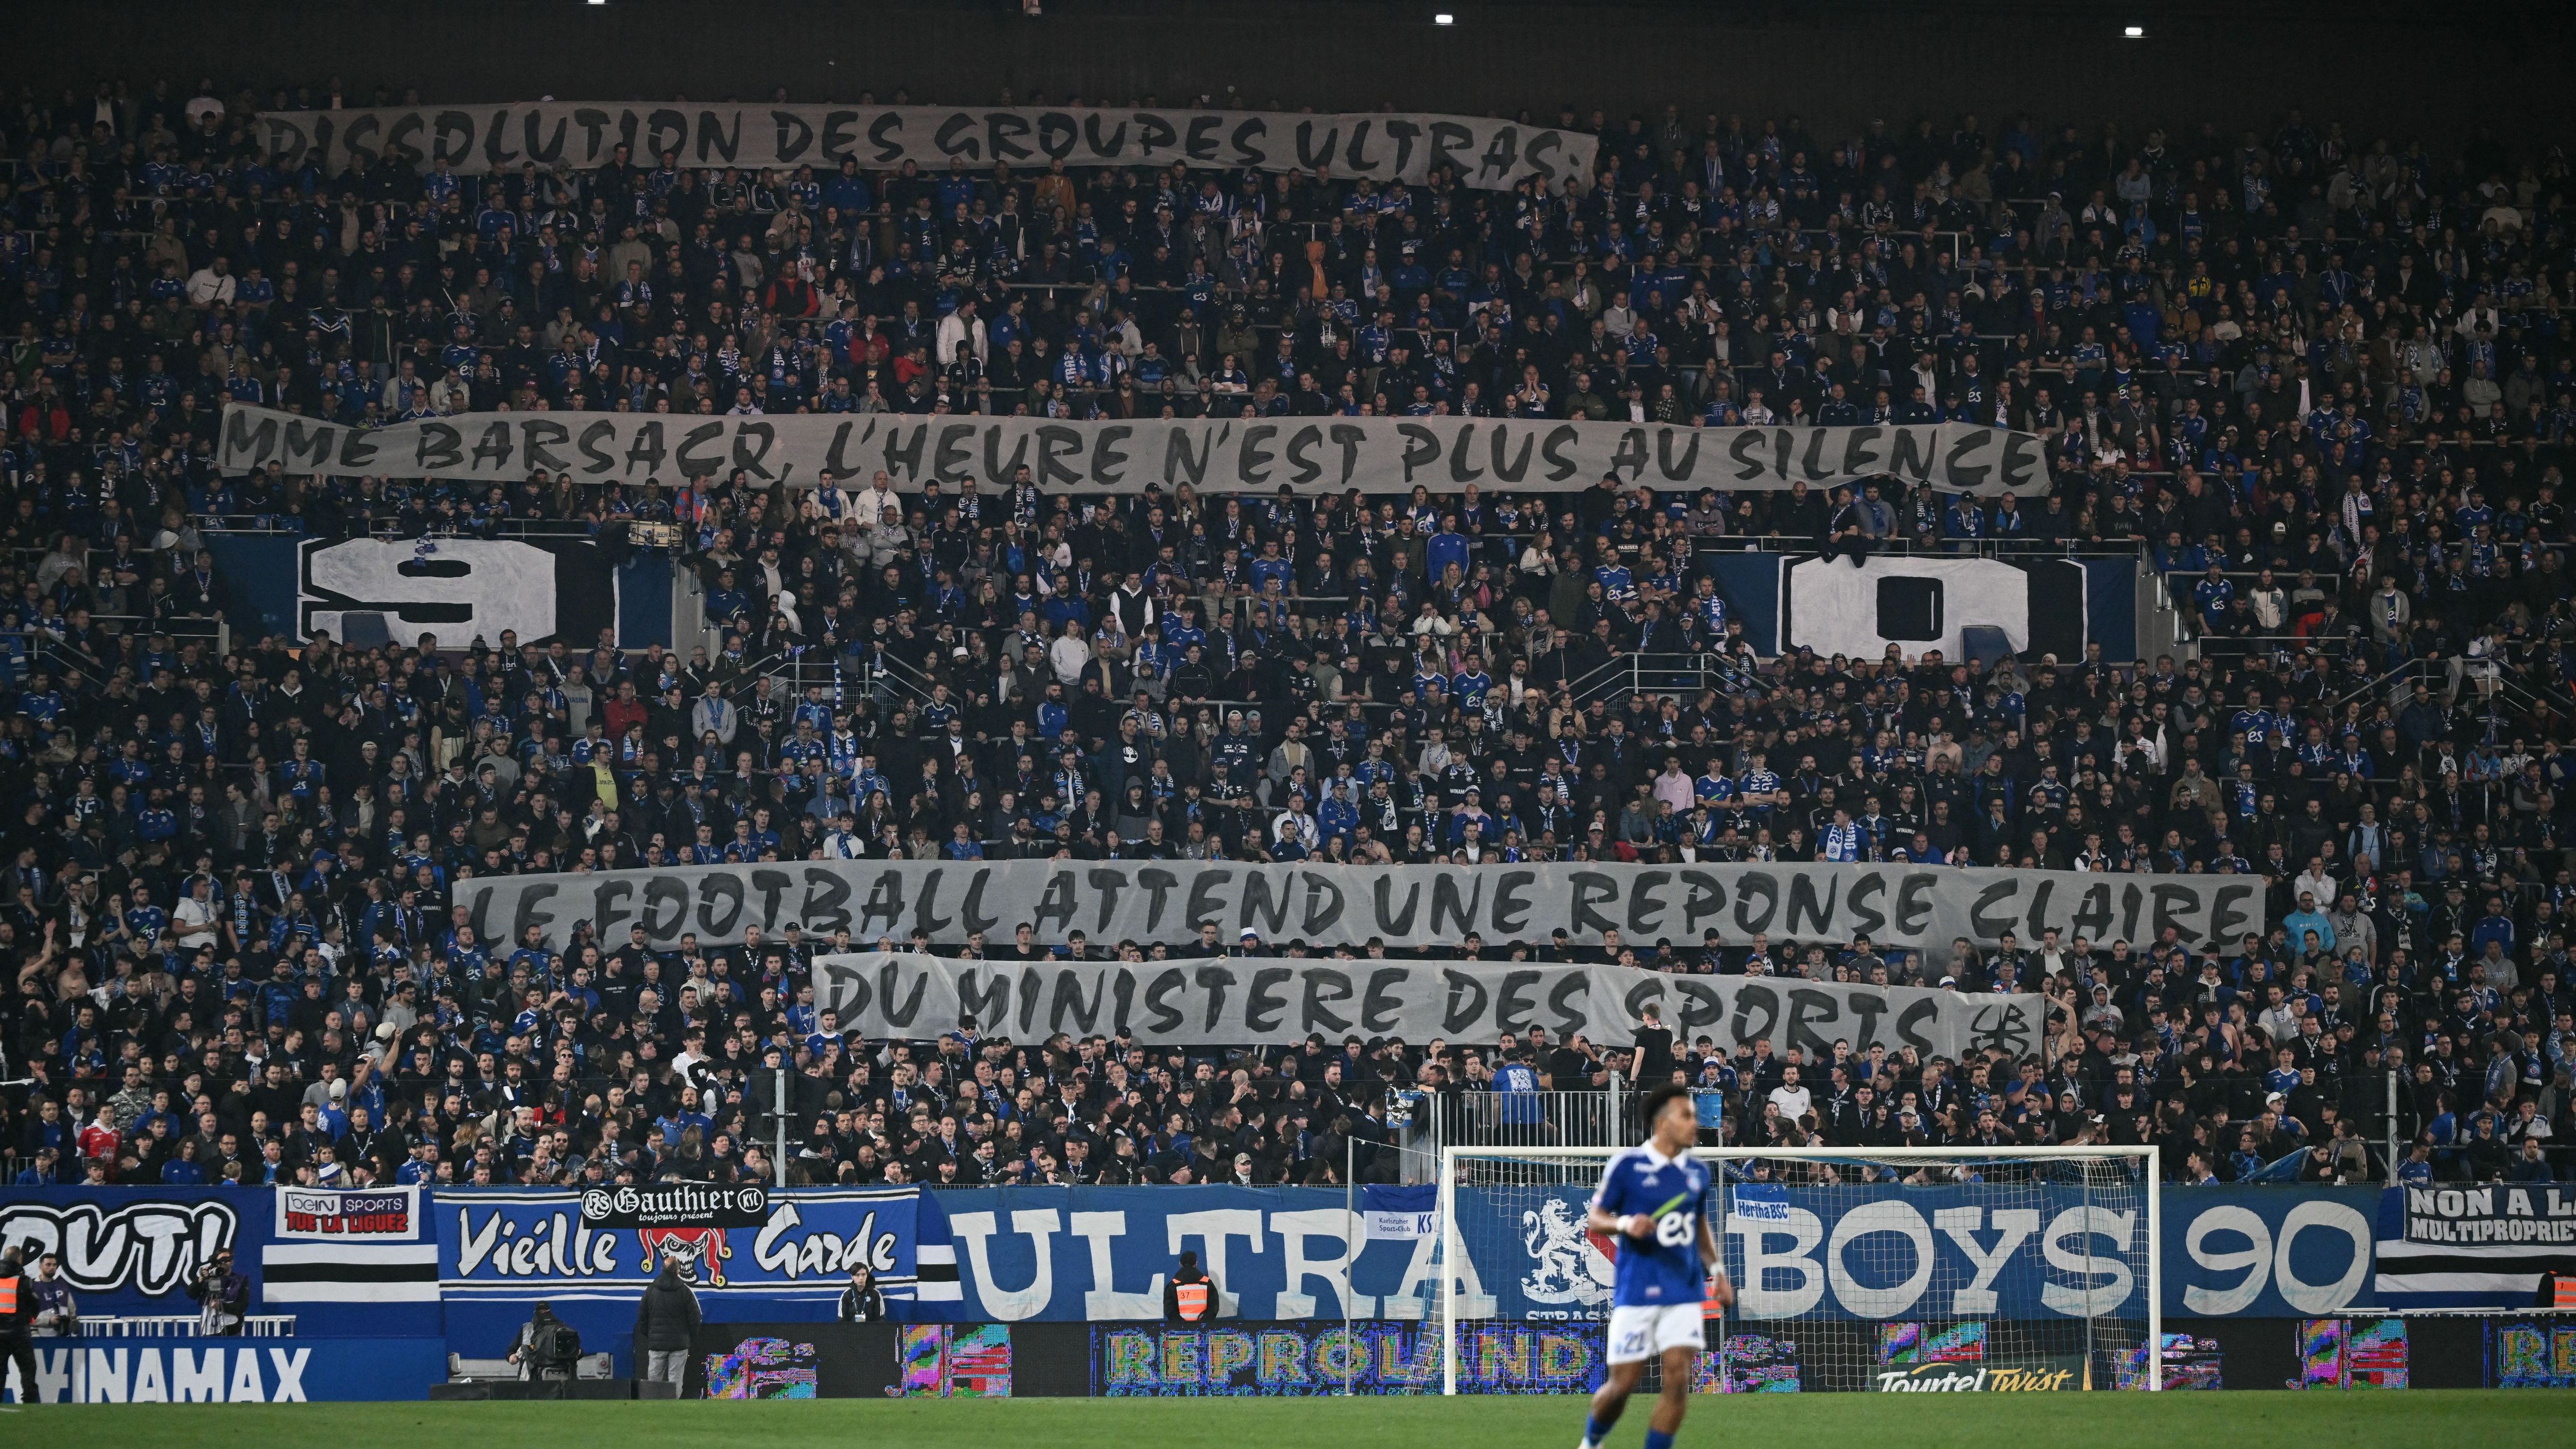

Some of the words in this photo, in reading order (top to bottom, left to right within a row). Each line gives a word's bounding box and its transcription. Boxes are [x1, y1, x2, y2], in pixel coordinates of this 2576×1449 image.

[266, 108, 741, 167] DISSOLUTION
[771, 109, 903, 163] DES
[934, 112, 1267, 165] GROUPES
[1968, 391, 1981, 403] es
[224, 410, 383, 467] MME
[415, 419, 793, 482] BARSACQ,
[825, 417, 1133, 485] L'HEURE
[1163, 420, 1367, 486] N'EST
[1397, 423, 1579, 483] PLUS
[1611, 427, 1700, 482] AU
[1728, 427, 2040, 487] SILENCE
[2211, 600, 2225, 610] es
[1466, 695, 1482, 707] es
[2247, 730, 2264, 742] es
[472, 882, 559, 945] LE
[593, 867, 999, 946] FOOTBALL
[1033, 868, 1346, 935] ATTEND
[1372, 870, 1536, 936] UNE
[1568, 870, 1938, 936] REPONSE
[1970, 877, 2254, 946] CLAIRE
[823, 960, 928, 1030] DU
[958, 965, 1408, 1035] MINISTERE
[1441, 969, 1591, 1033] DES
[1624, 977, 1940, 1057] SPORTS
[345, 1198, 403, 1212] SPORTS
[613, 1185, 735, 1213] Gauthier
[2409, 1185, 2494, 1217] NON
[2507, 1189, 2534, 1216] A
[286, 1211, 317, 1232] TUE
[321, 1213, 344, 1234] LA
[638, 1213, 677, 1223] toujours
[680, 1211, 713, 1223] présent
[1656, 1211, 1696, 1248] es
[457, 1206, 618, 1278] Vieille
[753, 1201, 896, 1280] Garde
[949, 1208, 1498, 1321] ULTRA
[1725, 1199, 2136, 1321] BOYS
[2183, 1200, 2371, 1315] 90
[1876, 1368, 1987, 1392] Tourtel
[1988, 1367, 2074, 1392] Twist
